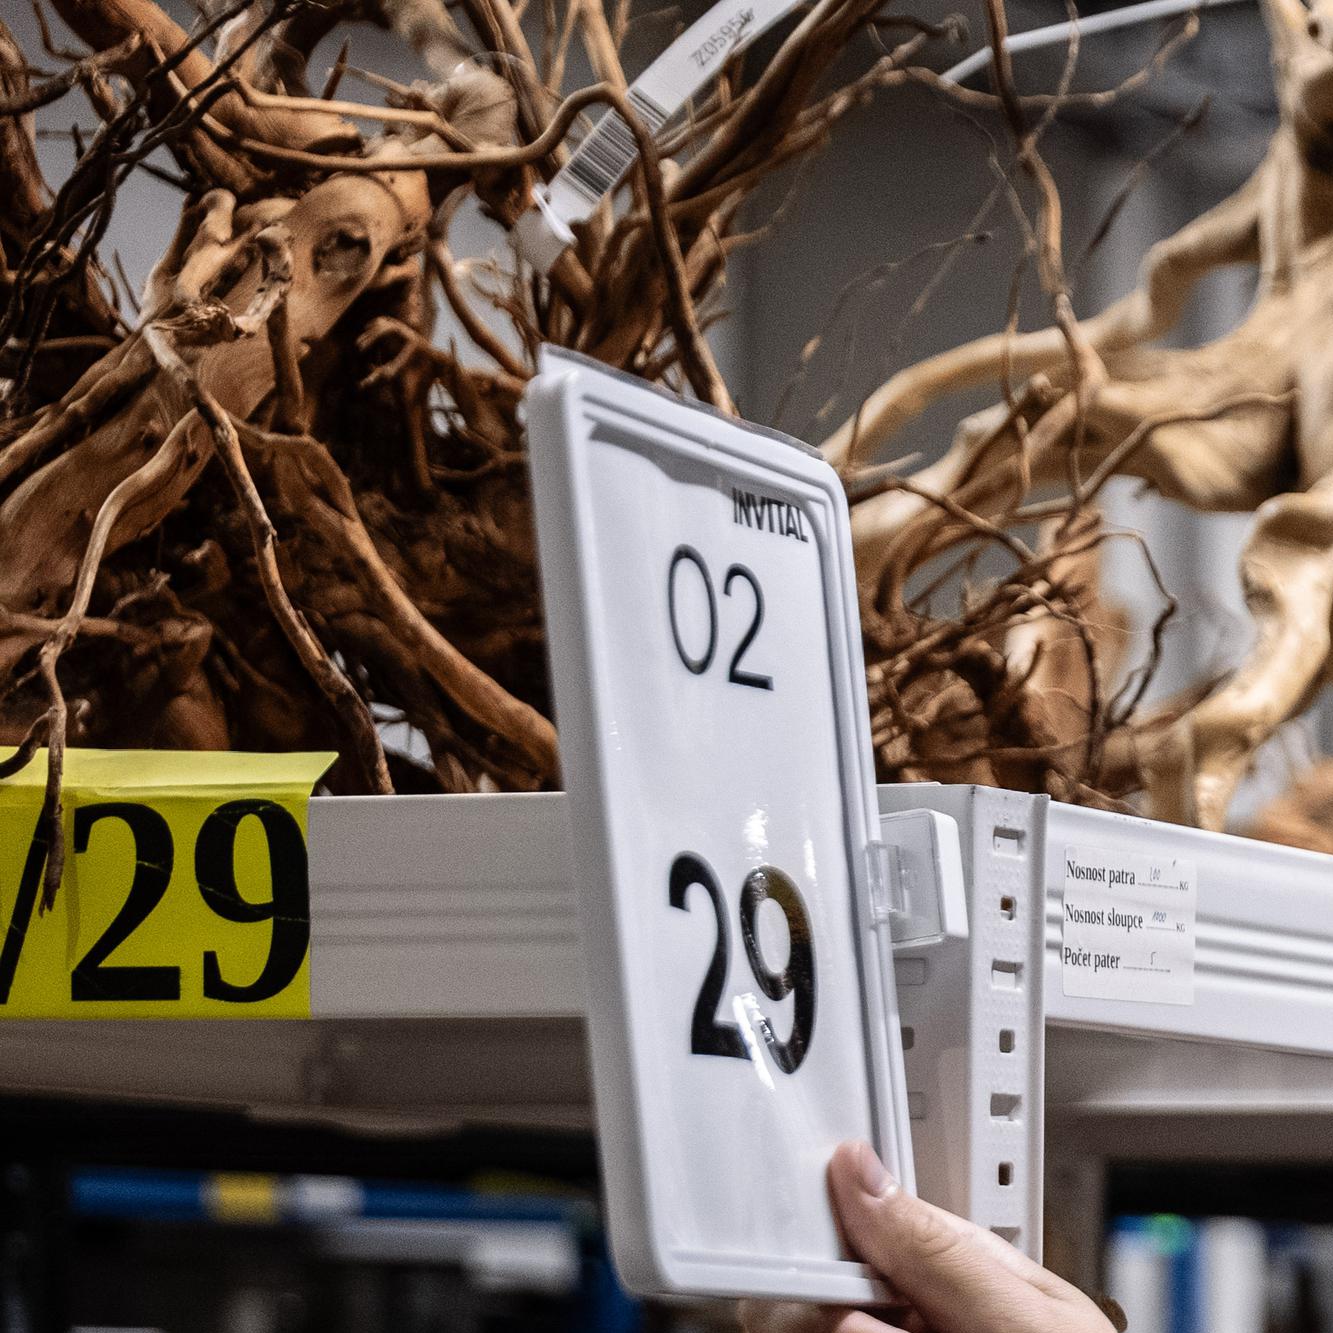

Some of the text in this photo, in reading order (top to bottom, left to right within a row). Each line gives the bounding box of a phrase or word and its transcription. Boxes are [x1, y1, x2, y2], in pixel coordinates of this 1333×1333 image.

[732, 487, 809, 543] INVITAL
[668, 543, 774, 691] 02
[1066, 860, 1106, 882] Nosnost
[1108, 868, 1136, 888] patra
[1065, 904, 1105, 926] Nosnost
[1107, 908, 1144, 932] sloupce
[669, 850, 818, 1075] 29
[1064, 947, 1091, 966] Počet
[1094, 952, 1121, 972] pater
